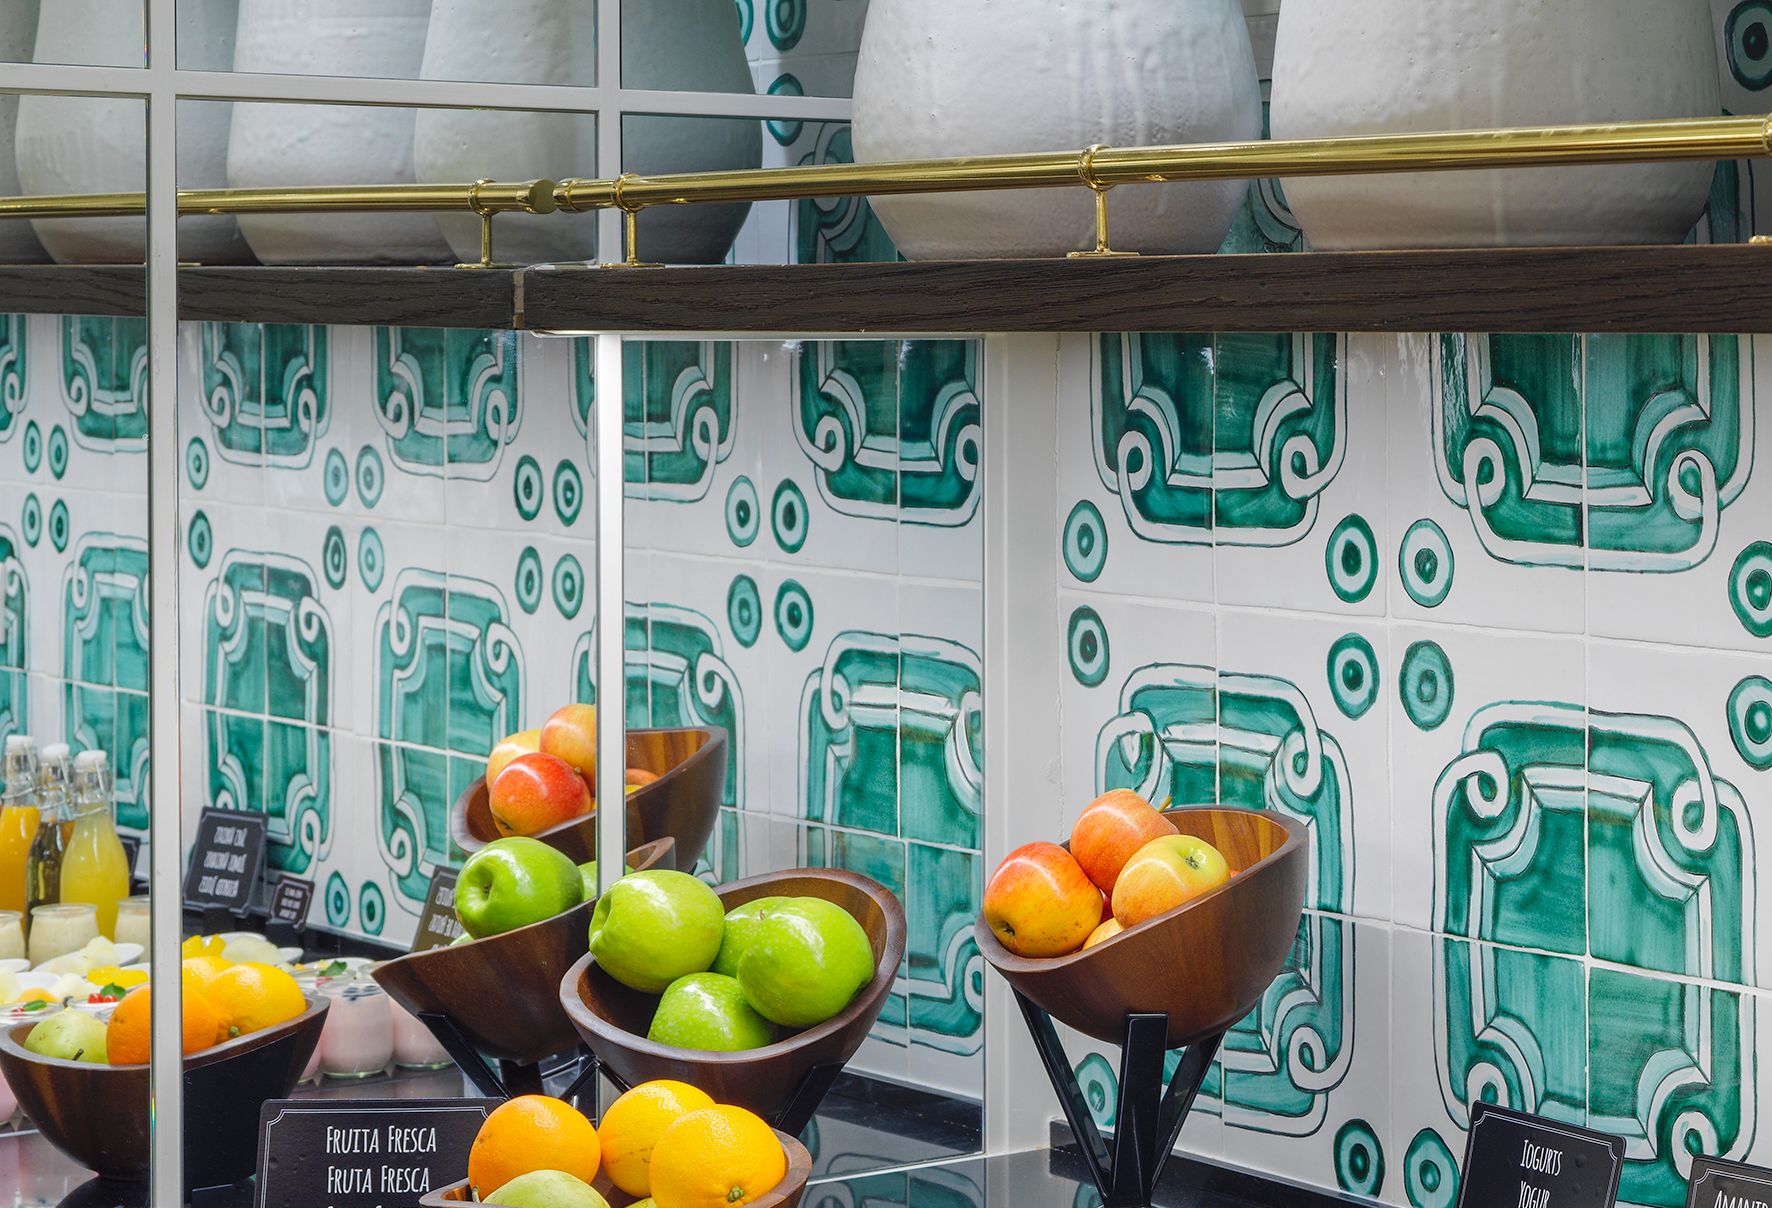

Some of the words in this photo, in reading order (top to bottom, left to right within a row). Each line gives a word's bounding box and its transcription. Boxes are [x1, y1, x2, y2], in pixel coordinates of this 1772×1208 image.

[326, 1126, 379, 1154] FRUITA
[388, 1125, 437, 1153] FRESCA
[1520, 1139, 1563, 1176] IOGURTS
[327, 1166, 372, 1194] FRUTA
[381, 1165, 430, 1193] FRESCA
